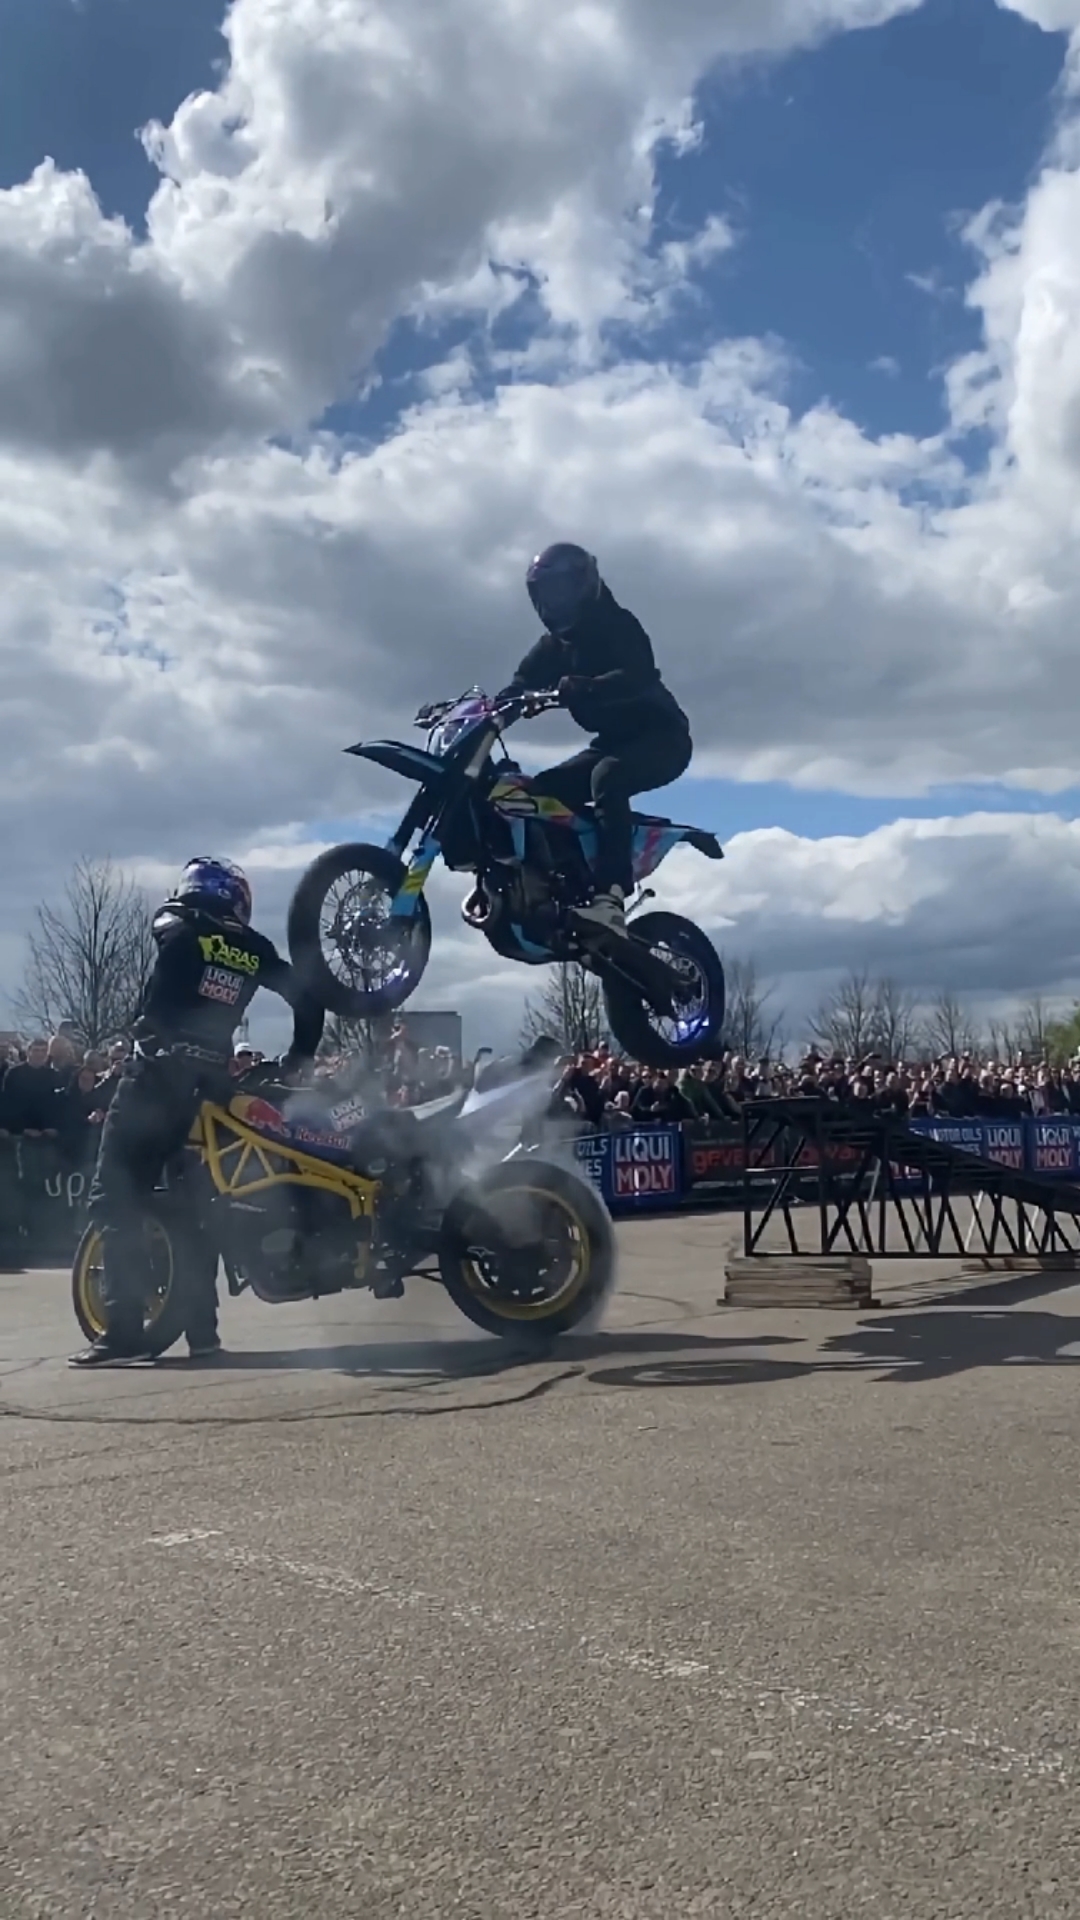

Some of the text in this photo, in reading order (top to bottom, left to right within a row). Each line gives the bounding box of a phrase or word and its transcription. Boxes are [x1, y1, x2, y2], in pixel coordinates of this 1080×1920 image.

[198, 935, 260, 969] TARAS
[207, 967, 240, 989] LIQUI
[202, 980, 239, 1001] MOLY
[962, 1127, 982, 1142] OILS
[987, 1128, 1021, 1147] LIQUI
[1035, 1127, 1071, 1146] LIQUI
[577, 1138, 609, 1157] OILS
[615, 1136, 670, 1162] LIQUI
[1036, 1147, 1072, 1167] MOLY
[616, 1165, 671, 1192] MOLY
